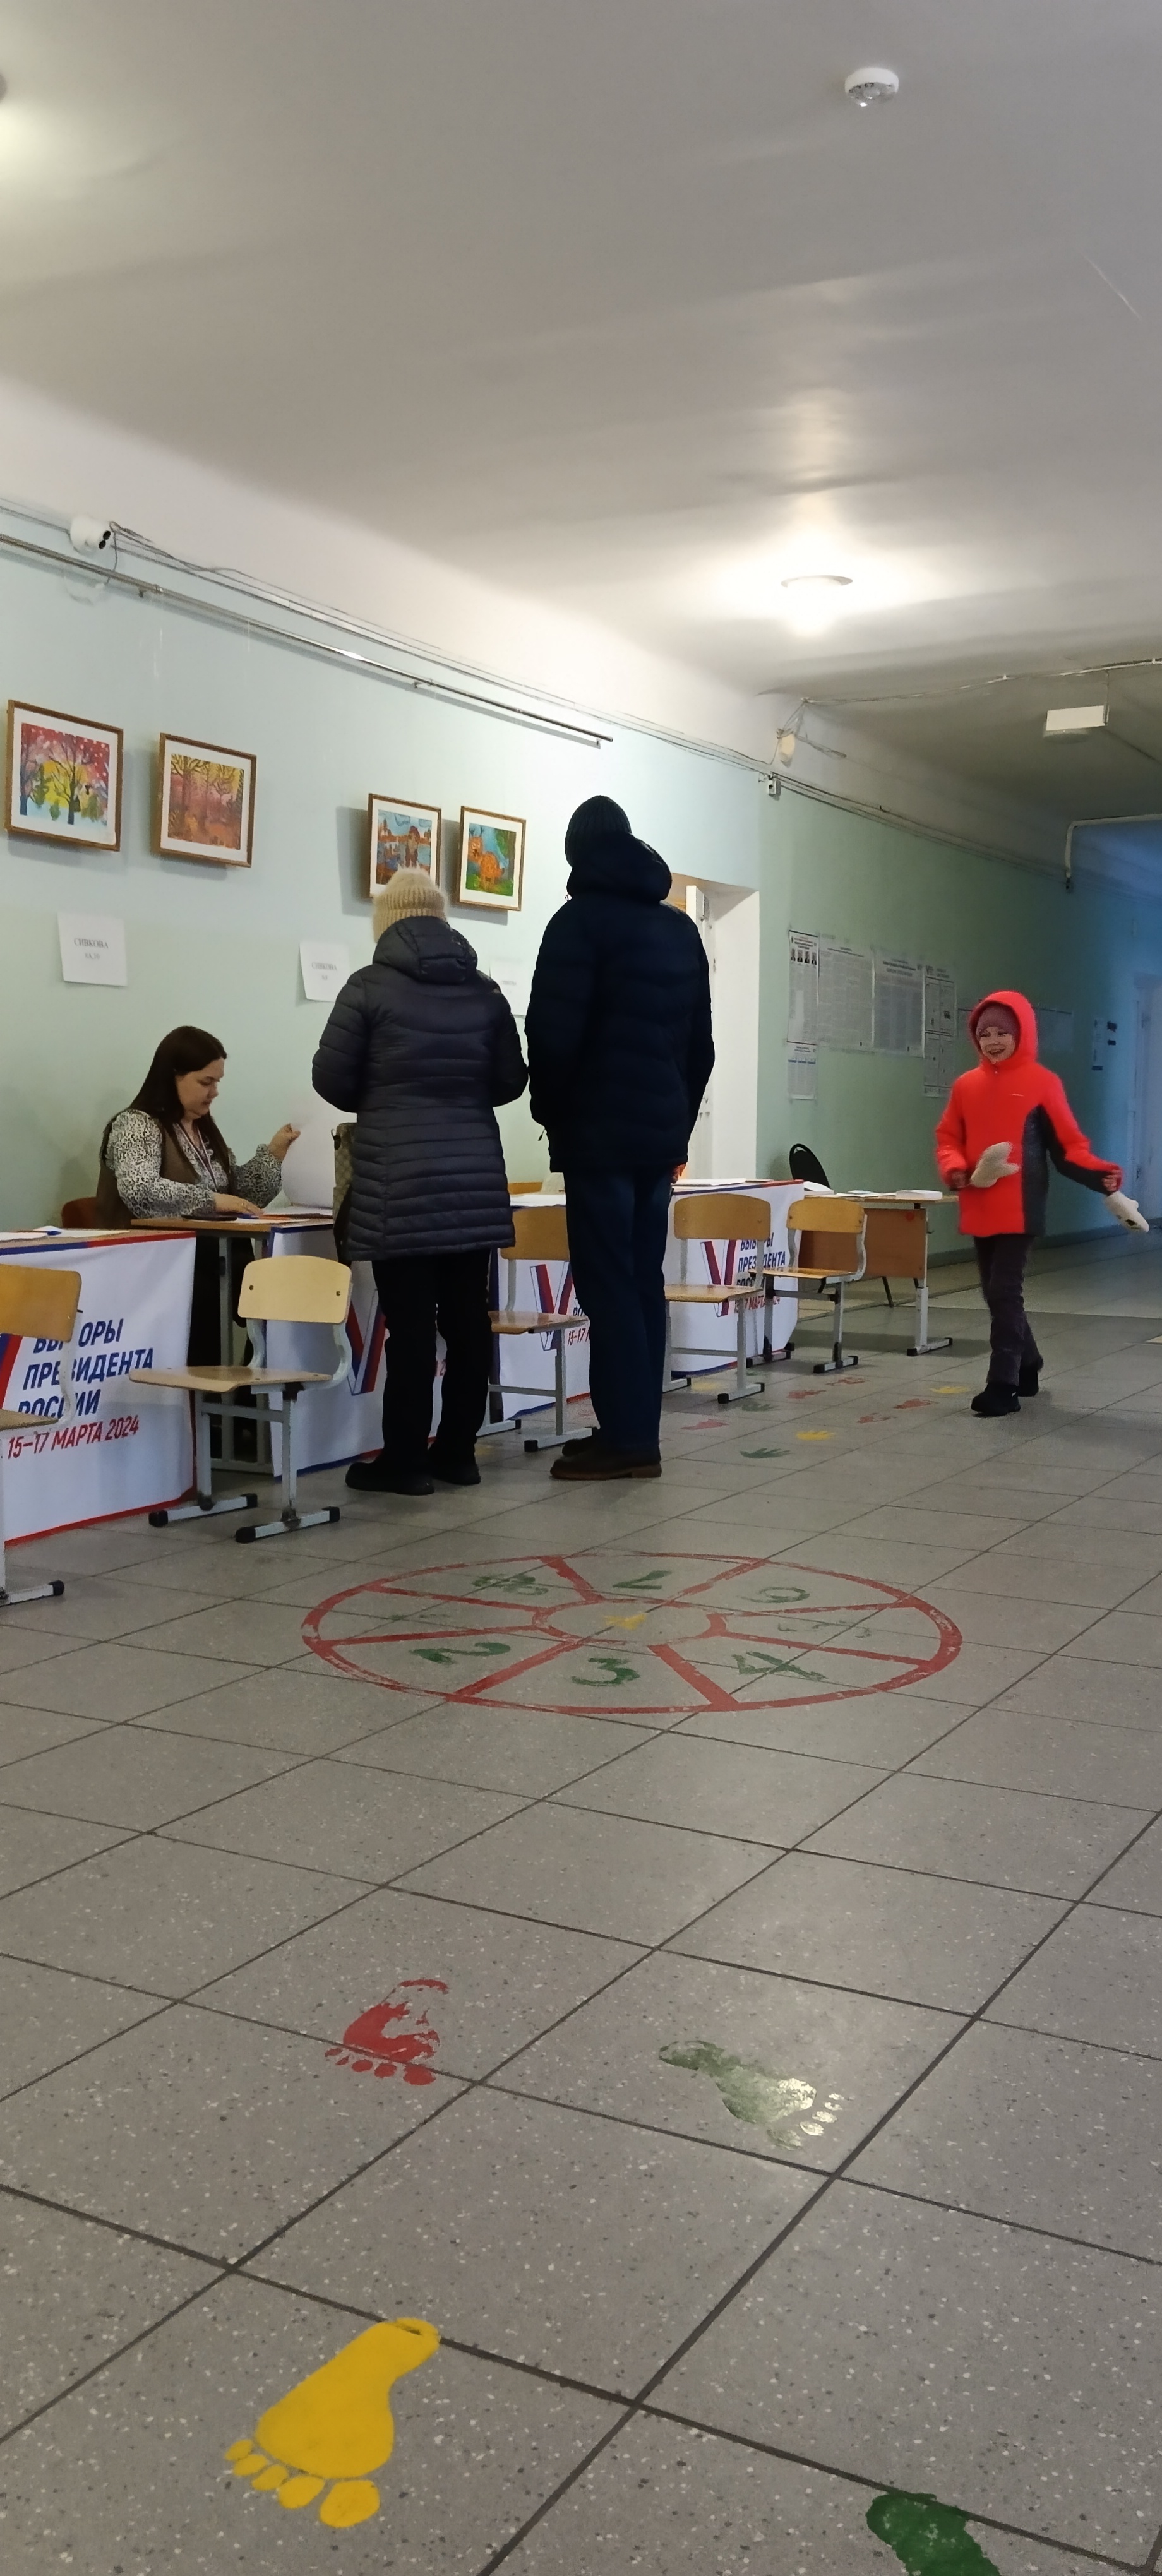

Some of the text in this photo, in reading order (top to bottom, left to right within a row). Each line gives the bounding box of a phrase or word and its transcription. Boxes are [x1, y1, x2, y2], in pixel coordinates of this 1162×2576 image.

[738, 1251, 786, 1273] ПРЕЗДЕНТА
[33, 1318, 124, 1354] ВЫОРЫ
[51, 1421, 104, 1451] МАРТА
[105, 1415, 139, 1441] 2024
[571, 1657, 640, 1687] 3
[731, 1651, 829, 1682] 4
